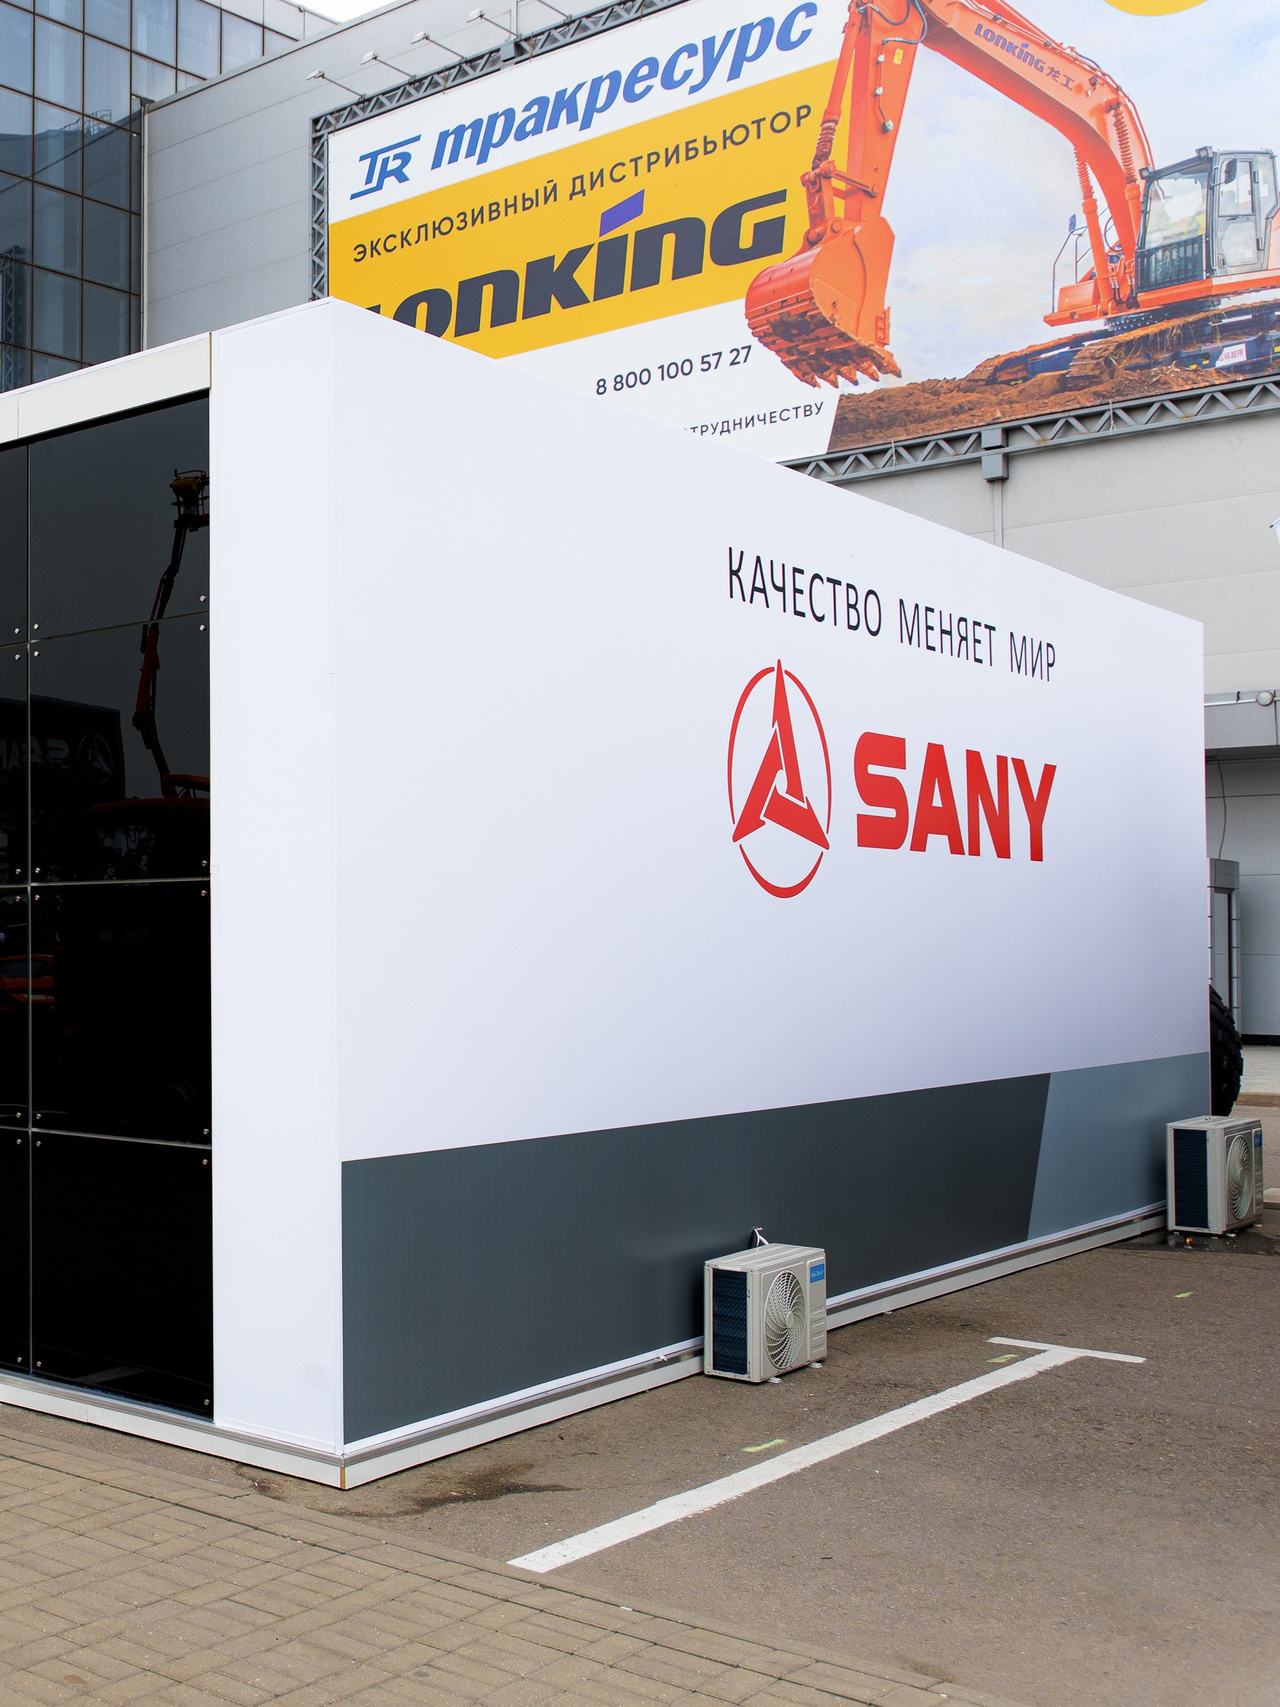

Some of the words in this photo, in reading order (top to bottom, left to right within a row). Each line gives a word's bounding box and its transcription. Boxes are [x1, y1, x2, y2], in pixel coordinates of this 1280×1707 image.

[431, 1, 818, 171] тракресурс
[353, 178, 558, 263] ЭКСКЛЮЗИВНЫЙ
[569, 104, 812, 200] ДИСТРИБЬЮТОР
[365, 188, 788, 338] ONKING
[596, 378, 607, 395] 8
[613, 368, 651, 392] 800
[658, 358, 693, 381] 100
[700, 351, 722, 372] 57
[729, 345, 752, 367] 27
[683, 401, 824, 436] ТРУДНИЧЕСТВУ
[728, 546, 882, 637] КАЧЕСТВО
[899, 598, 996, 667] МЕНЯЕТ
[1010, 631, 1056, 682] МИР
[854, 731, 1057, 862] SANY
